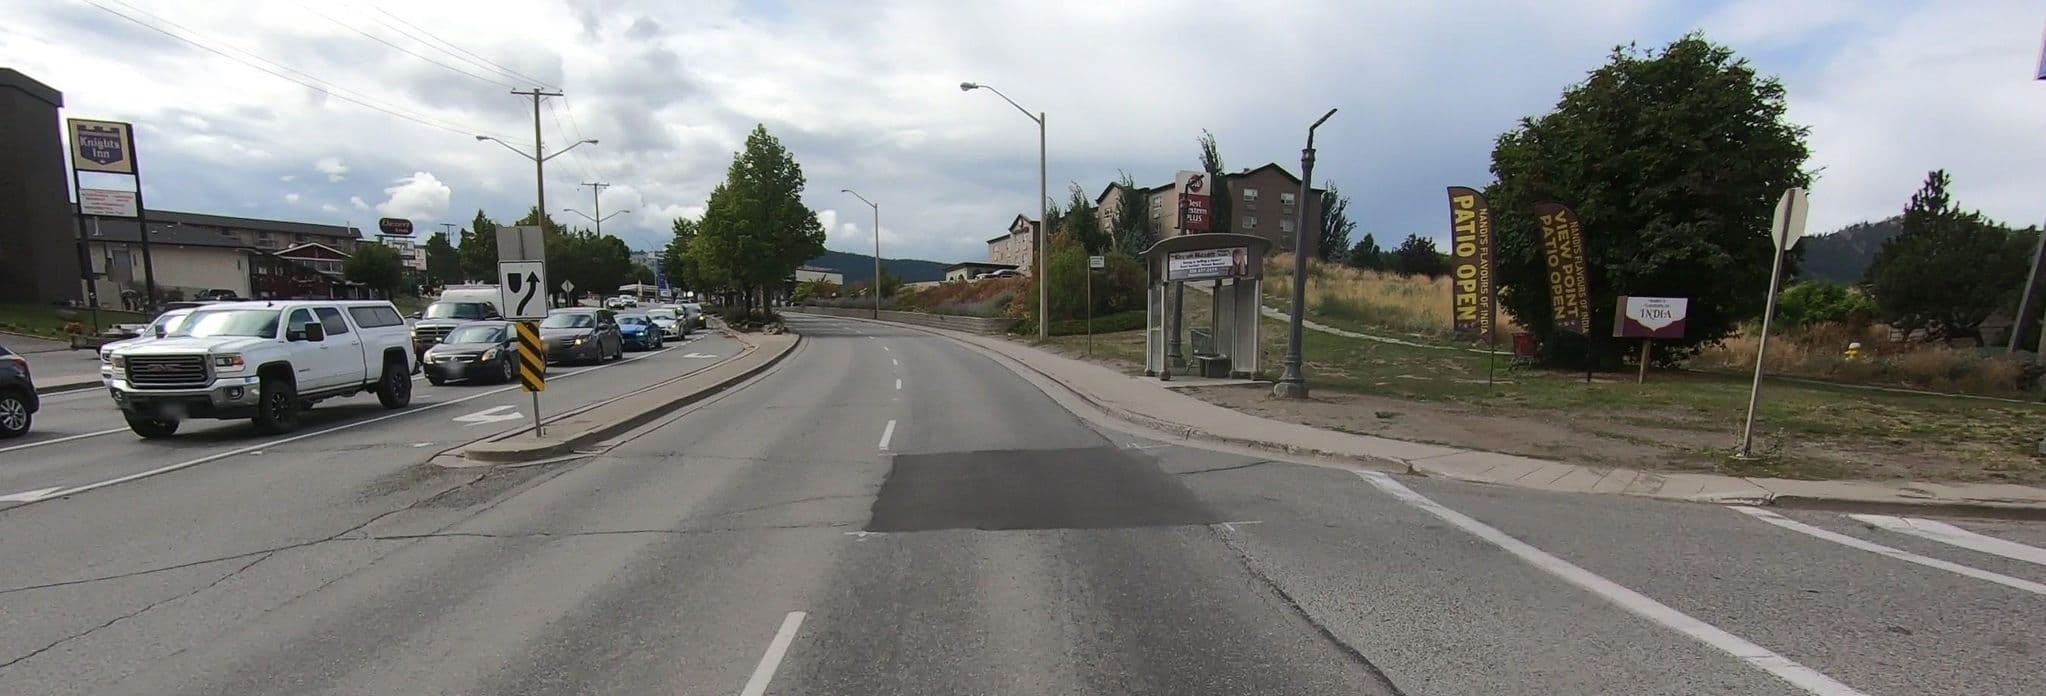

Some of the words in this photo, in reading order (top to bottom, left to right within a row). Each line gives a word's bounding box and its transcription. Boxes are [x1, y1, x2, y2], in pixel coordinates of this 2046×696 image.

[79, 135, 121, 150] Knights
[92, 147, 111, 159] Inn
[1453, 194, 1477, 258] PATIO
[1479, 208, 1488, 245] NANDI'S
[1555, 209, 1573, 259] VIEW
[1479, 246, 1489, 294] FLAVOURS
[1540, 214, 1559, 268] PATIO
[1550, 271, 1566, 320] OPEN
[1574, 255, 1587, 299] FLAVOURS
[1456, 264, 1477, 321] OPEN
[1479, 296, 1489, 309] OF
[1562, 263, 1579, 318] POINT
[1479, 310, 1489, 334] INDIA
[1640, 307, 1672, 321] INDIA
